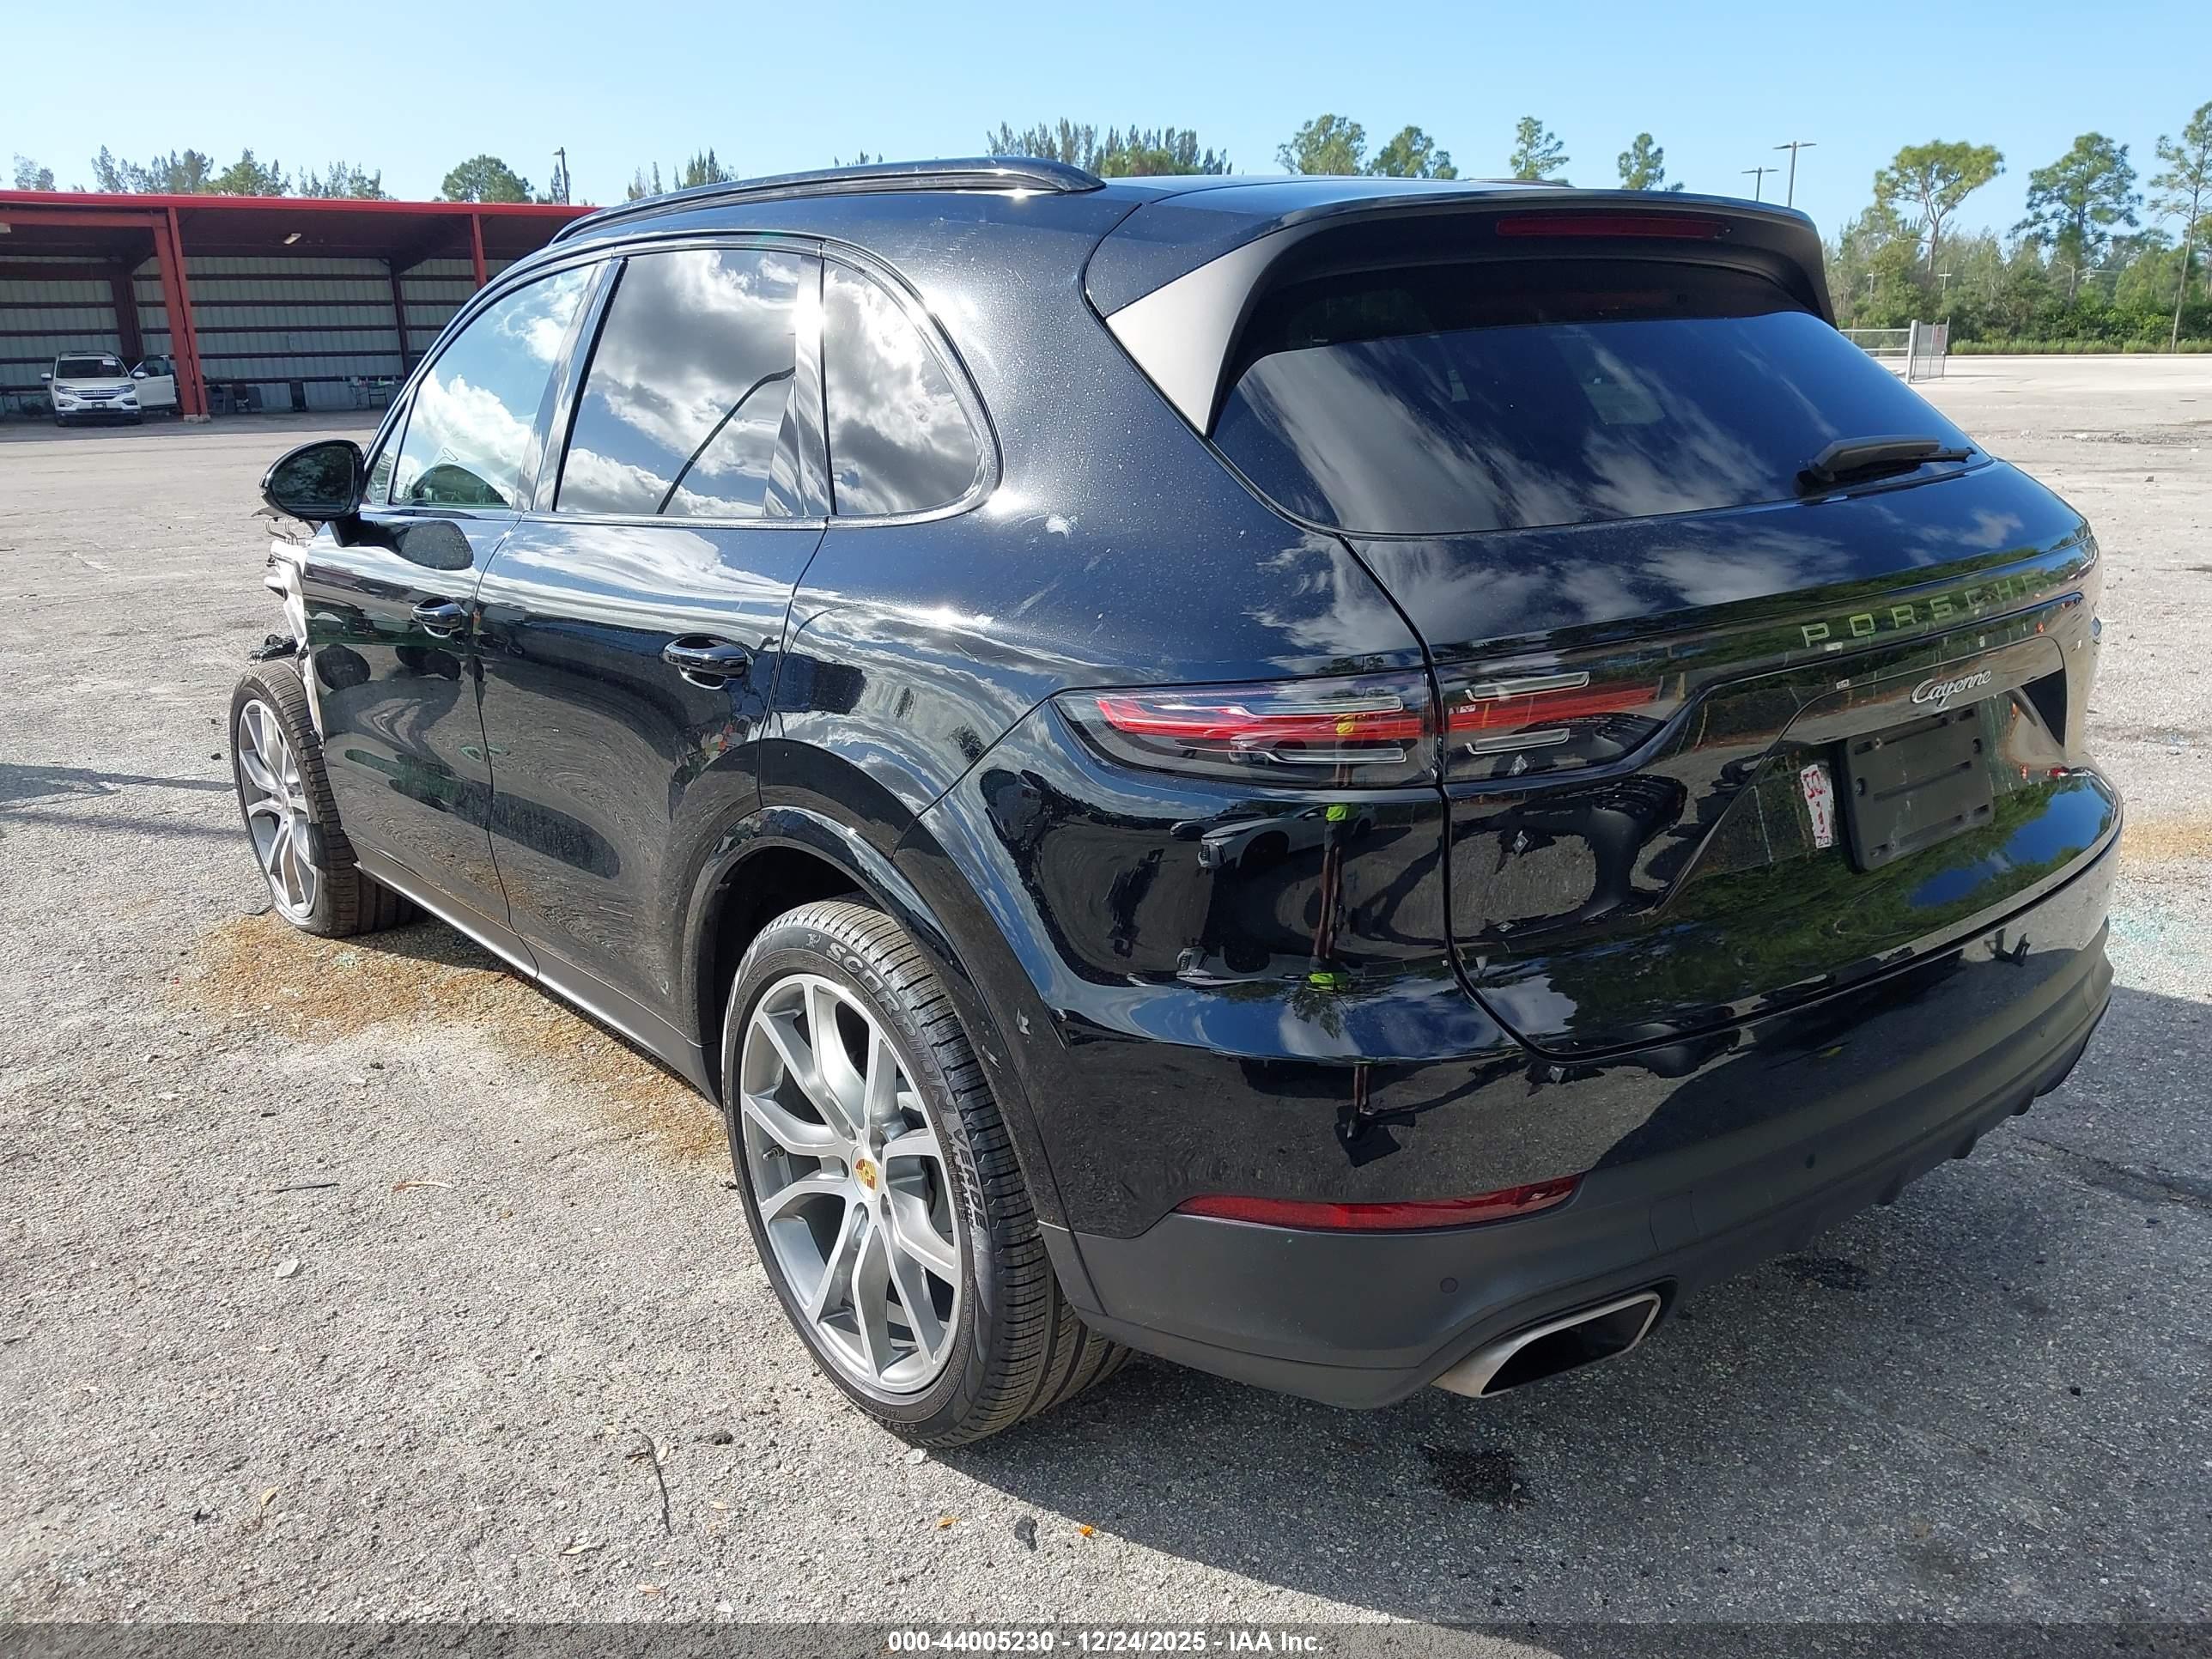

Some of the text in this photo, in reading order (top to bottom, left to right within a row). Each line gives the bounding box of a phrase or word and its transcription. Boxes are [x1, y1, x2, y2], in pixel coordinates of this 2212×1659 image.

[1801, 570, 2045, 648] PORSCHE
[1911, 670, 1992, 708] Cayenne
[825, 942, 957, 1115] SCORPION
[952, 1127, 988, 1231] VERDE
